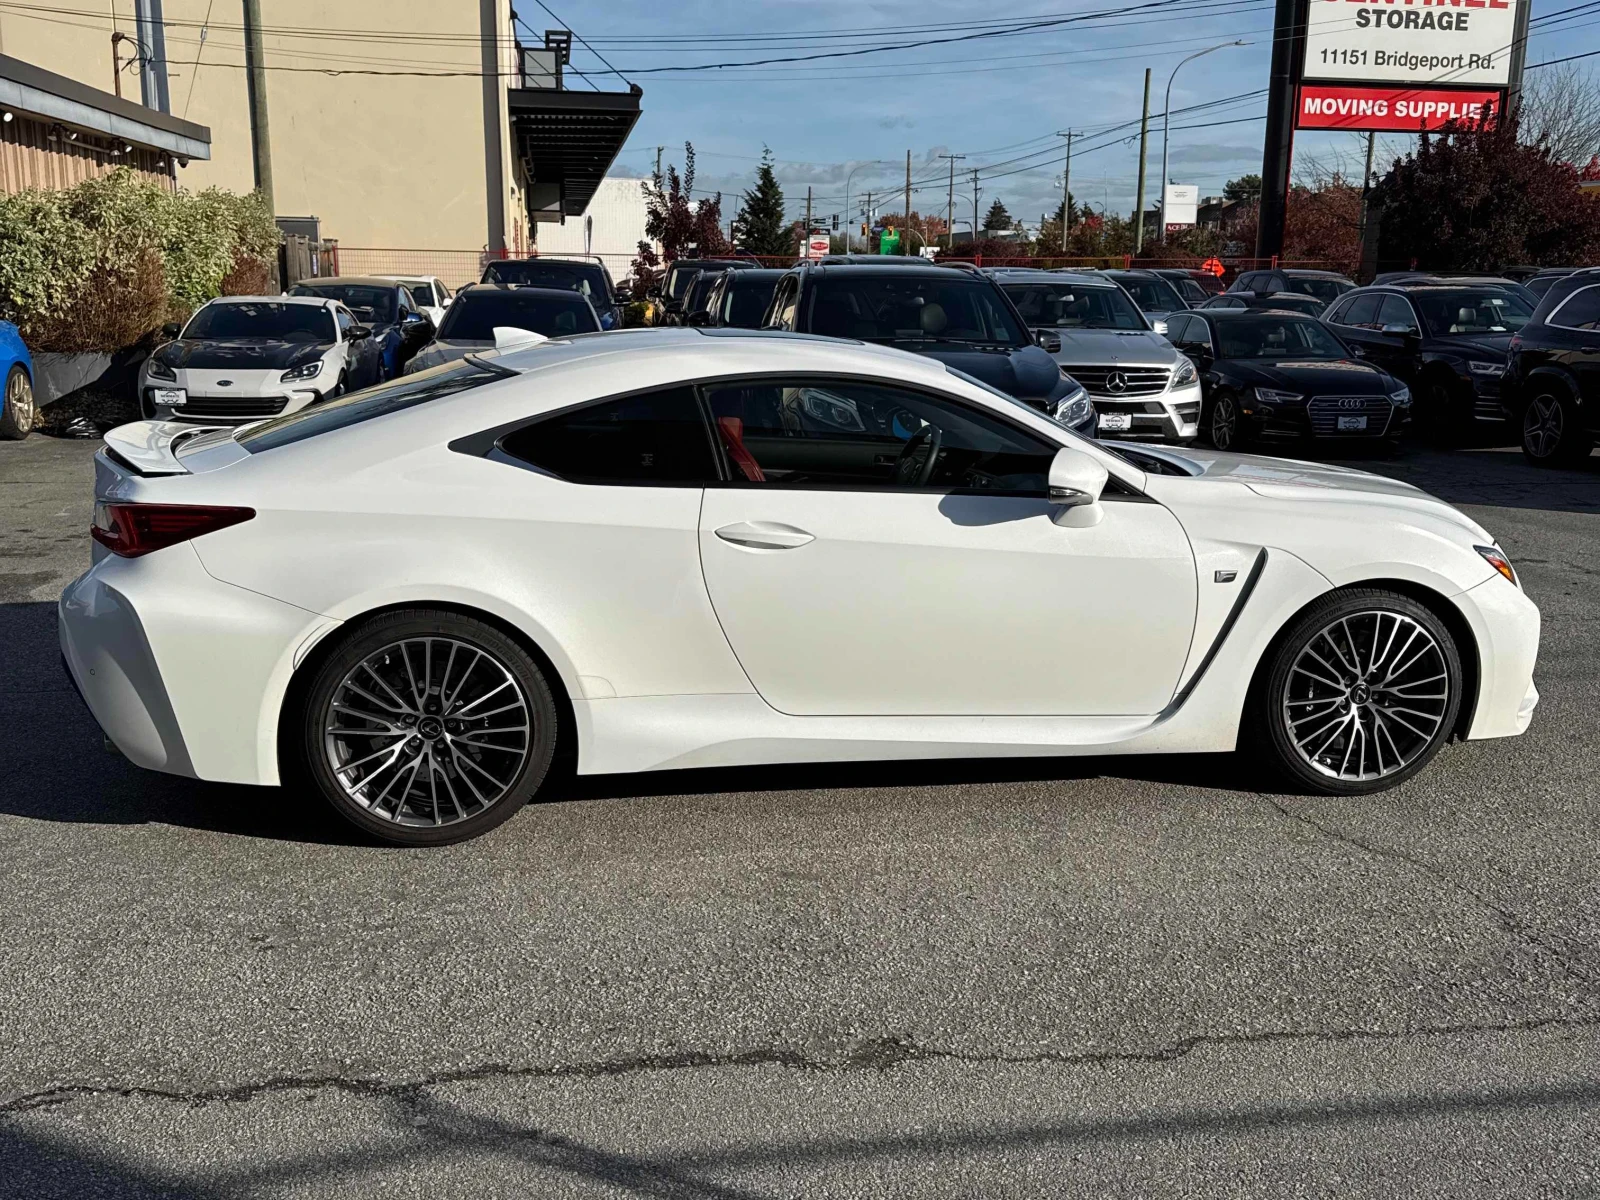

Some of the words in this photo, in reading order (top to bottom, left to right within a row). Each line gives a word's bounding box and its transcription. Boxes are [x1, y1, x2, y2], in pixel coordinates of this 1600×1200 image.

[1355, 8, 1470, 31] STORAGE
[1320, 48, 1368, 65] 11151
[1374, 50, 1464, 71] Bridgeport
[1469, 53, 1496, 70] Rd.
[1304, 97, 1388, 117] MOVING
[1394, 100, 1494, 120] SUPPLIE
